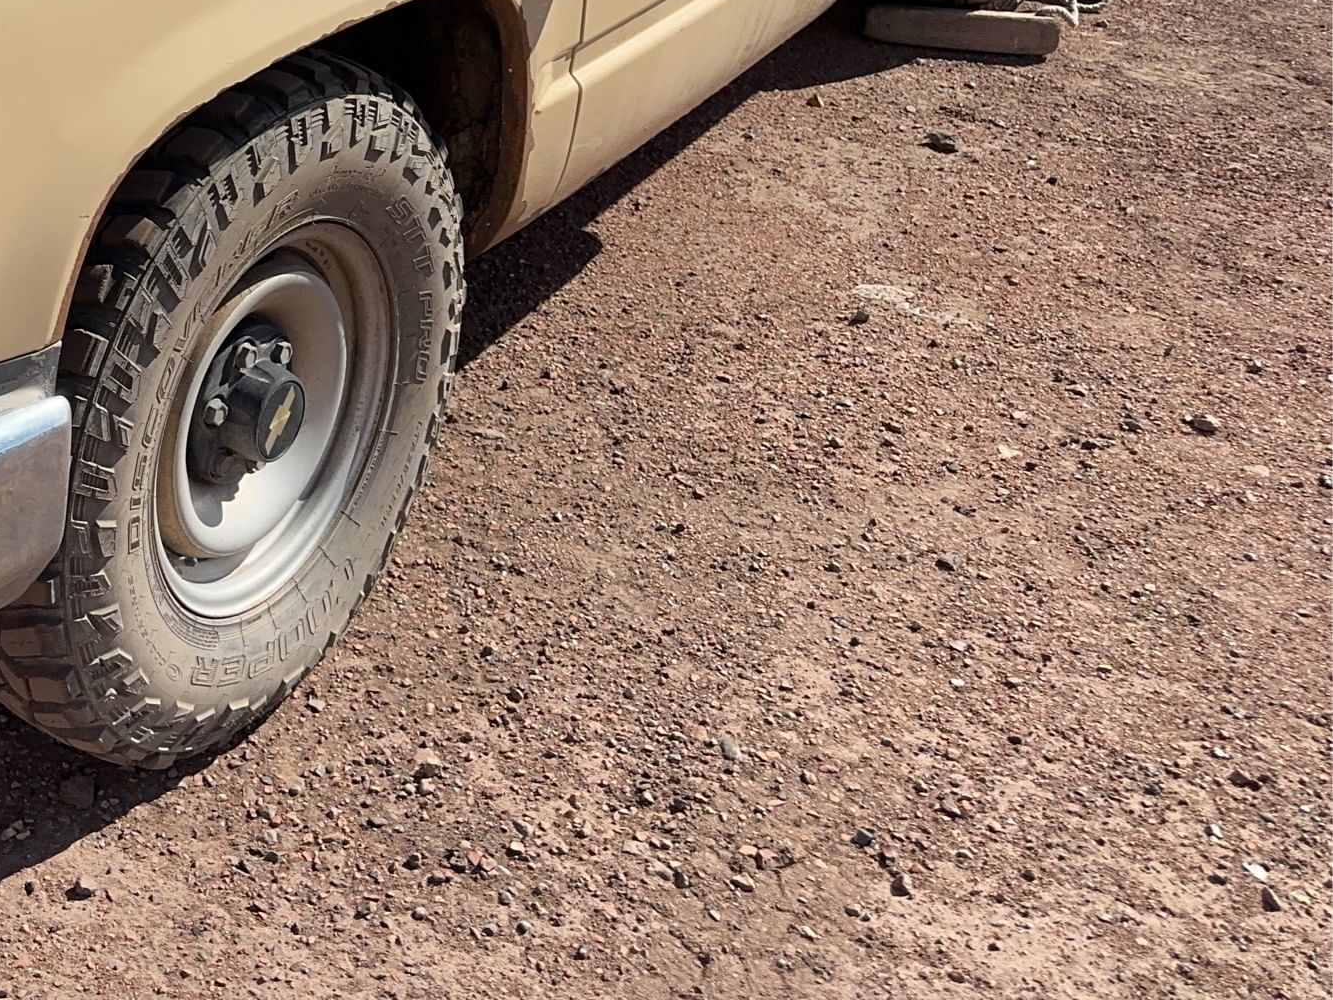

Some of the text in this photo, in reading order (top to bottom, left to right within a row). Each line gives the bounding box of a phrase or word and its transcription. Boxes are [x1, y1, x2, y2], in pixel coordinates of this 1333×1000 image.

[385, 194, 436, 385] STT PRO
[190, 557, 355, 688] COOPER
